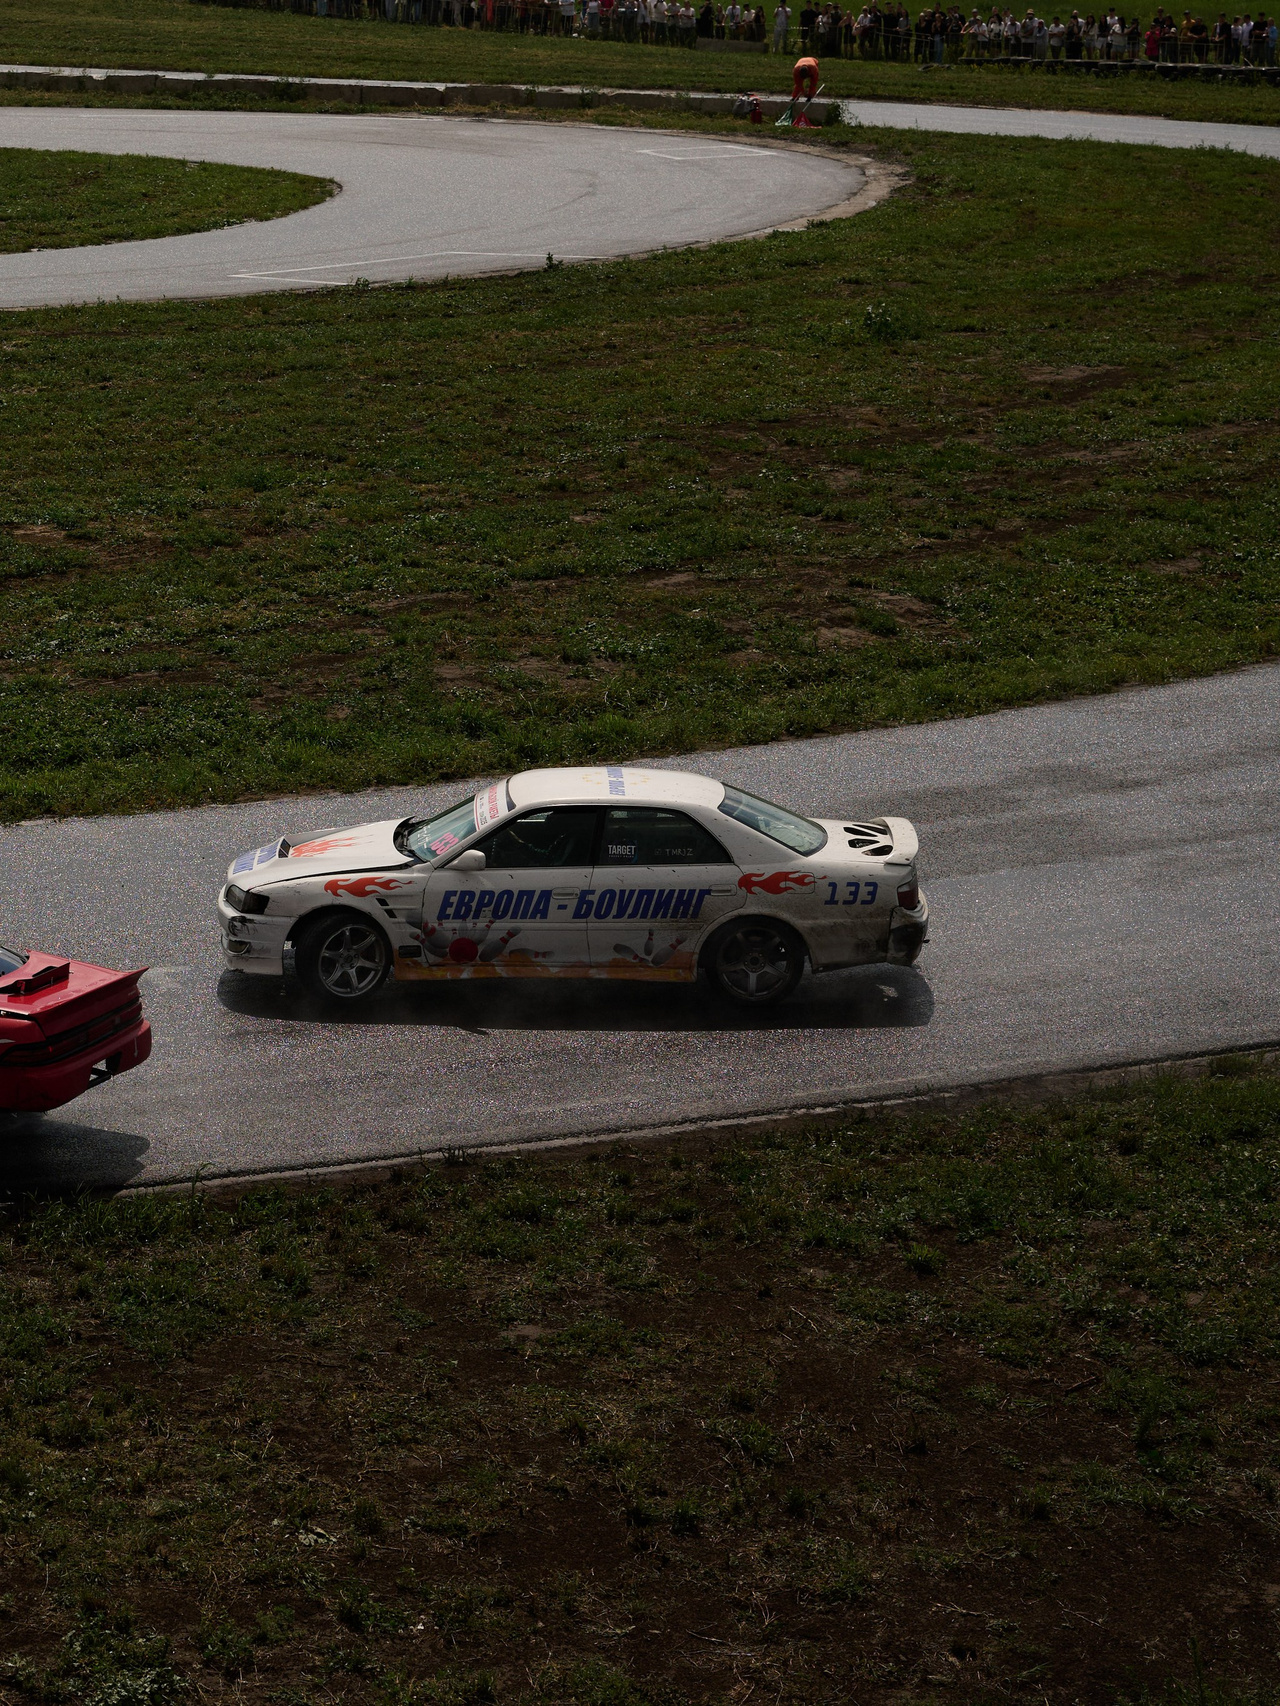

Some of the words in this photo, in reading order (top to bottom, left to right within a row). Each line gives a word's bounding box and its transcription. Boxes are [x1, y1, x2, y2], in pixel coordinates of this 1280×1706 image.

[608, 844, 636, 855] TARGET
[436, 889, 554, 921] ЕВРОПА
[571, 888, 714, 920] БОУЛИНГ
[824, 881, 879, 906] 133
